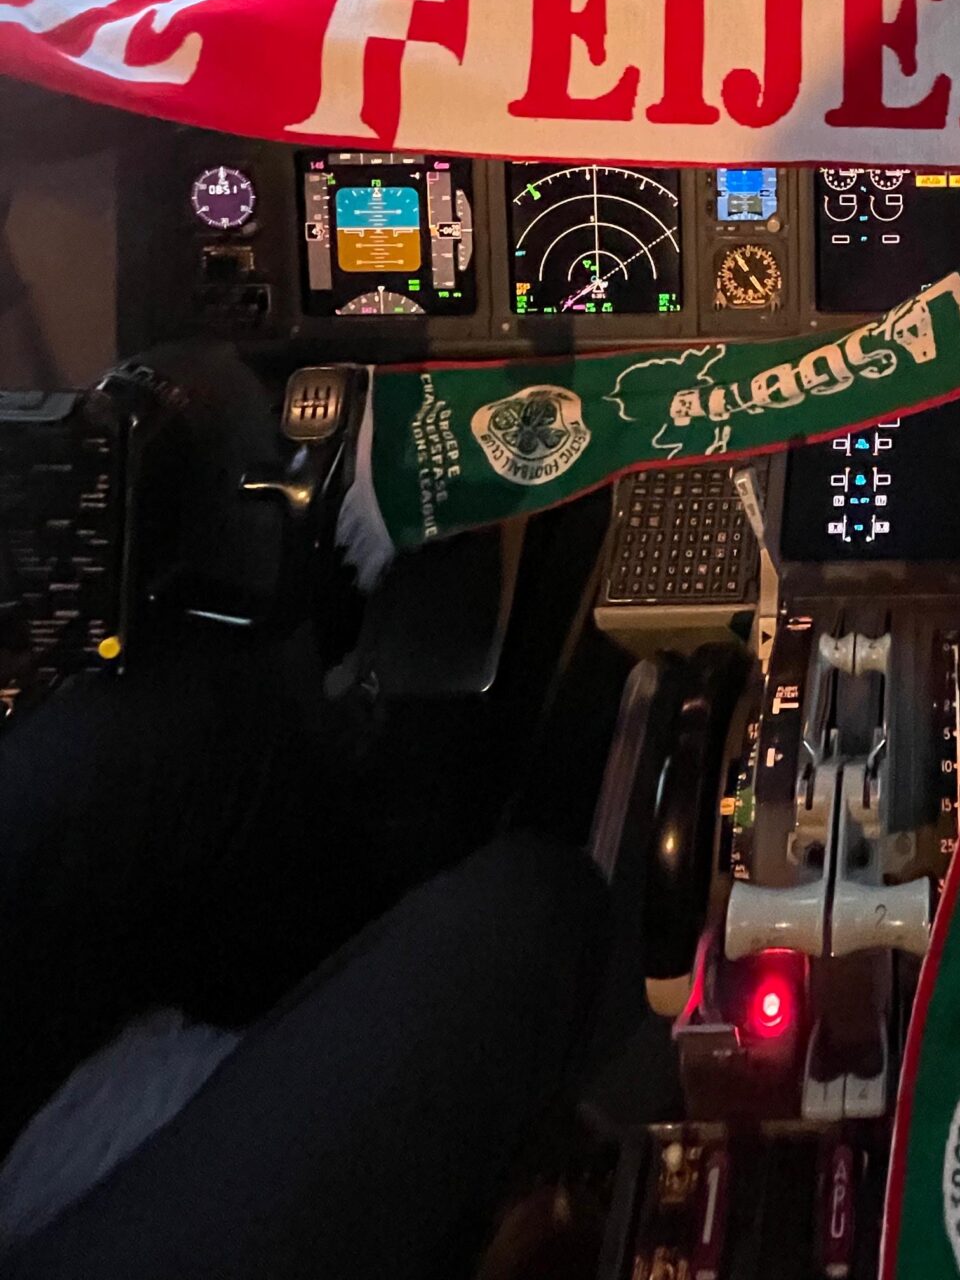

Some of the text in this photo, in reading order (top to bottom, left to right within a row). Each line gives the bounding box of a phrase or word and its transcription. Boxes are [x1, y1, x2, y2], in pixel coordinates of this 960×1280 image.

[480, 433, 505, 461] CLUB
[501, 457, 561, 480] FOOTBALL
[943, 726, 951, 740] 5
[941, 760, 953, 773] 10
[941, 799, 952, 812] 15
[940, 839, 955, 853] 25
[830, 1159, 849, 1239] APU
